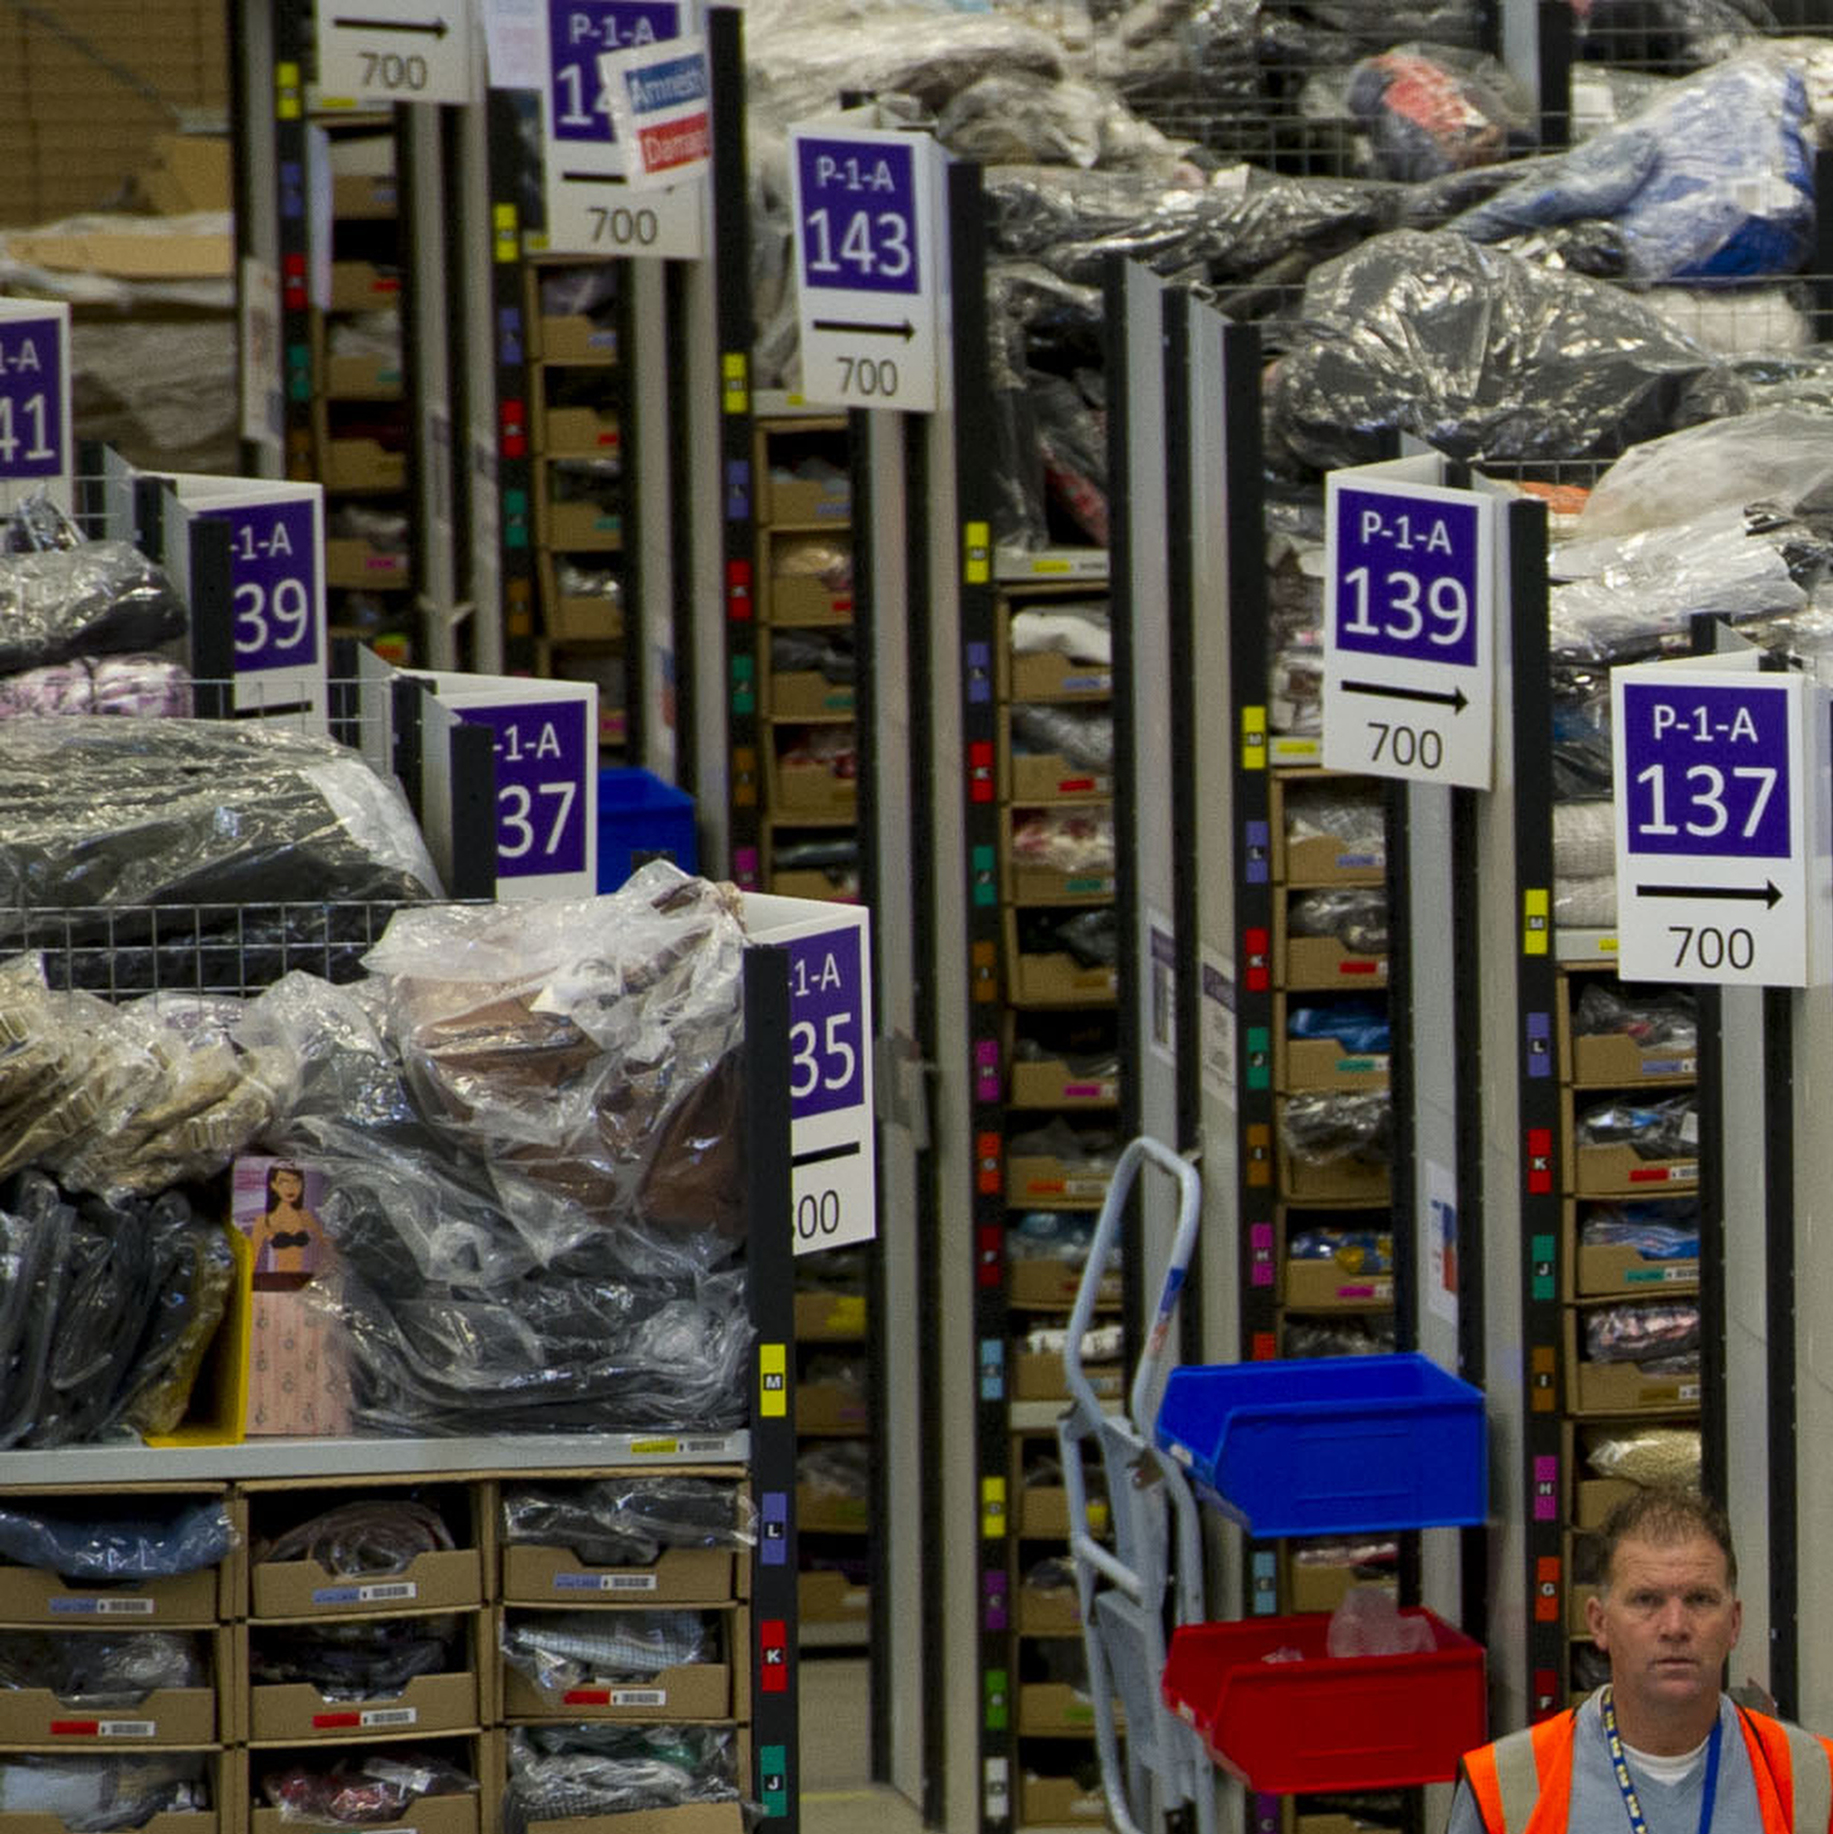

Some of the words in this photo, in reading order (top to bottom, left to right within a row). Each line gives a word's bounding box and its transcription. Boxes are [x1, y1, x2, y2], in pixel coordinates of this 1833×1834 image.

[359, 52, 428, 91] 700
[817, 156, 894, 191] P-1-A
[587, 207, 657, 246] 700
[807, 209, 910, 277] 143
[837, 357, 897, 397] 700
[0, 393, 55, 463] 41
[231, 521, 293, 561] -1-A
[1362, 511, 1452, 554] P-1-A
[234, 578, 308, 653] 39
[1345, 567, 1467, 645] 139
[493, 722, 561, 761] -1-A
[1654, 705, 1758, 742] P-1-A
[1367, 722, 1442, 770] 700
[498, 782, 576, 858] 37
[1638, 764, 1777, 837] 137
[1530, 918, 1544, 928] M
[1669, 927, 1754, 969] 700
[789, 953, 841, 997] -1-A
[790, 1012, 855, 1098] 35
[1533, 1041, 1544, 1053] L
[1535, 1158, 1546, 1169] K
[793, 1190, 839, 1240] 00
[1539, 1263, 1549, 1276] J
[766, 1376, 780, 1388] M
[1540, 1483, 1551, 1494] H
[768, 1524, 779, 1538] L
[1542, 1583, 1555, 1596] G
[768, 1650, 780, 1662] K
[1540, 1696, 1551, 1709] F
[768, 1776, 778, 1790] J
